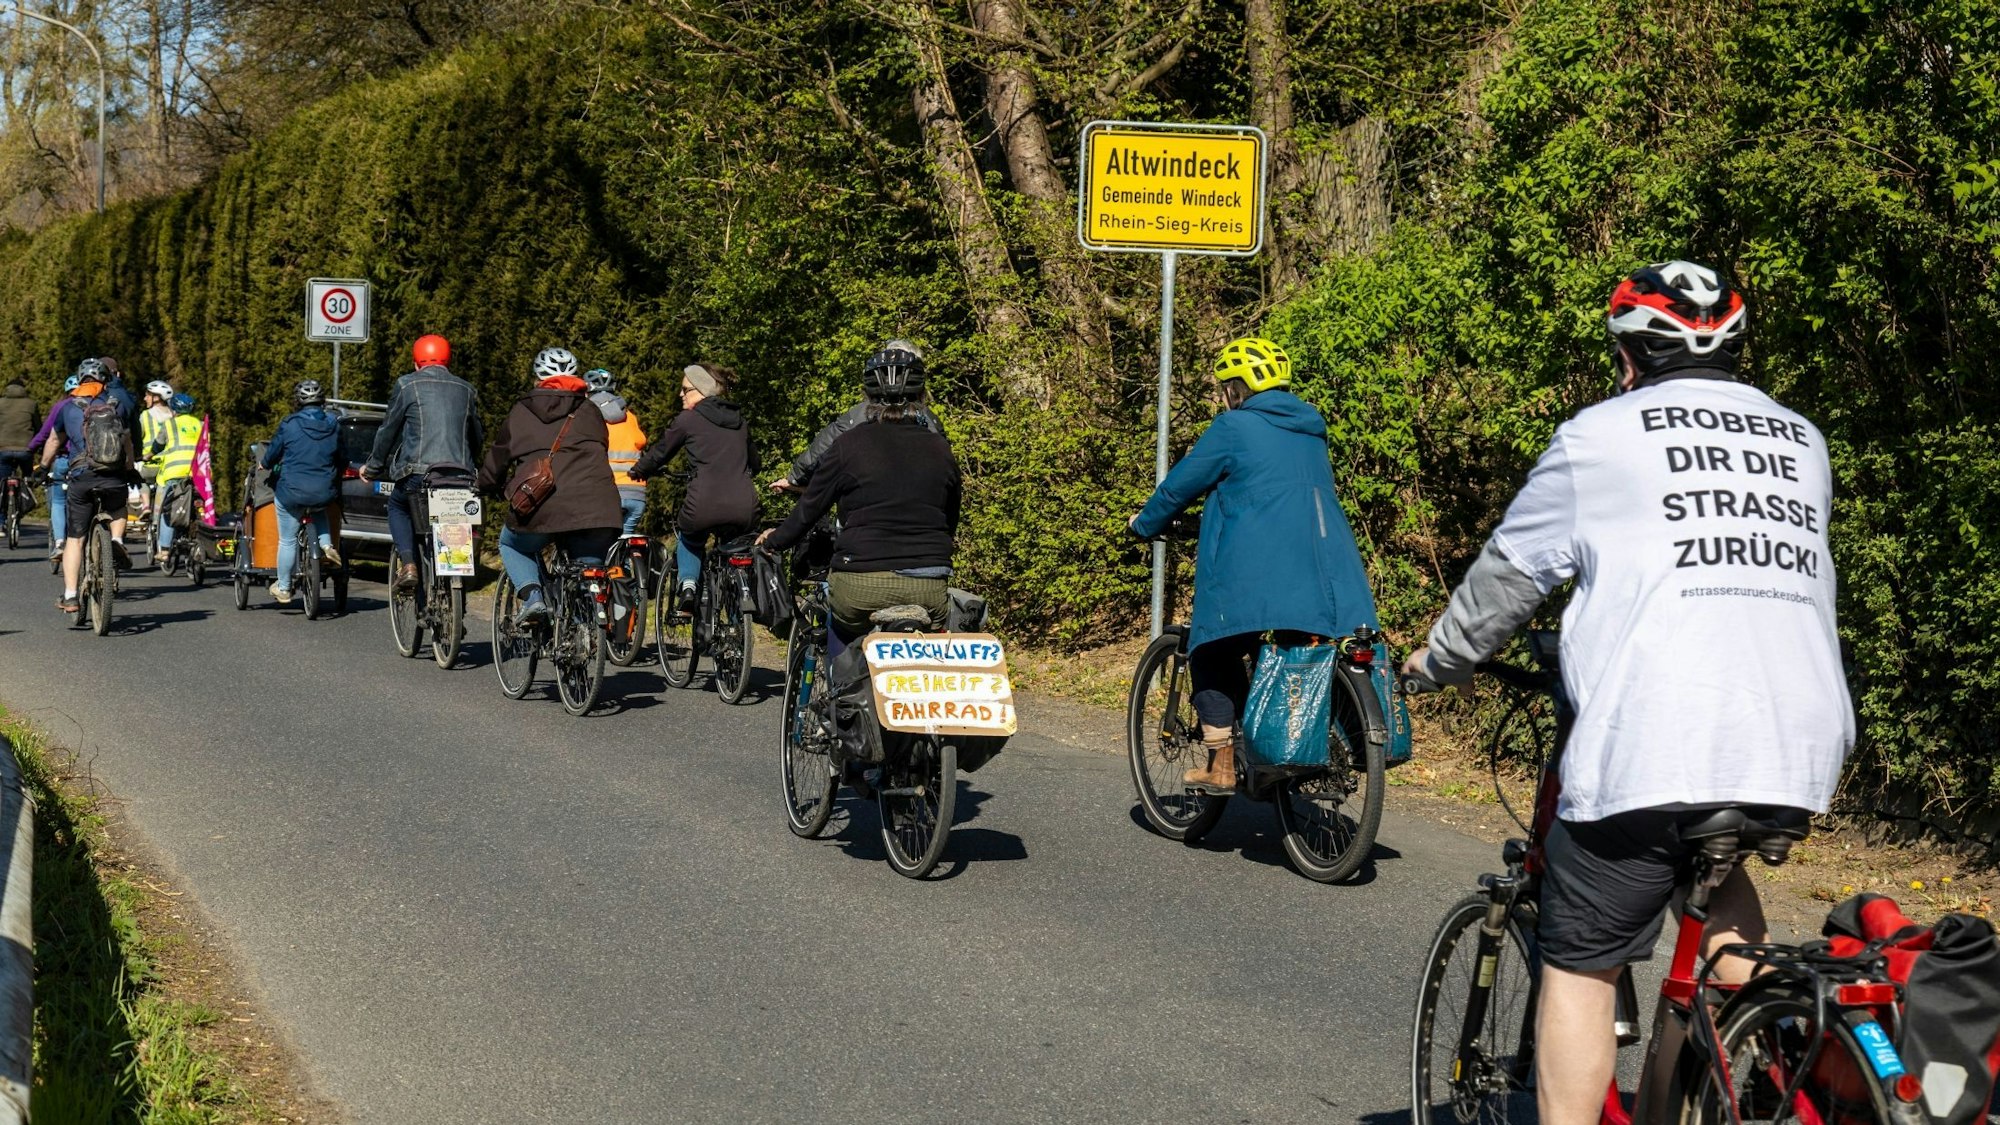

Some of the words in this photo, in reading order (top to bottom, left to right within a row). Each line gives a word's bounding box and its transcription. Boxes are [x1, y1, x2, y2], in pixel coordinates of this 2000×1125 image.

[1106, 147, 1240, 179] Altwindeck
[1102, 186, 1173, 205] Gemeinde
[1181, 189, 1241, 207] Windeck
[1099, 214, 1243, 234] Rhein-Sieg-Kreis
[328, 297, 349, 314] 30
[324, 325, 351, 335] ZONE
[1641, 406, 1810, 448] EROBERE
[1665, 445, 1734, 473] DIR
[1742, 450, 1799, 482] DIE
[1662, 489, 1819, 534] STRASSE
[1673, 532, 1818, 579] ZURÜCK!
[875, 639, 1001, 663] FRISCHLUFT?
